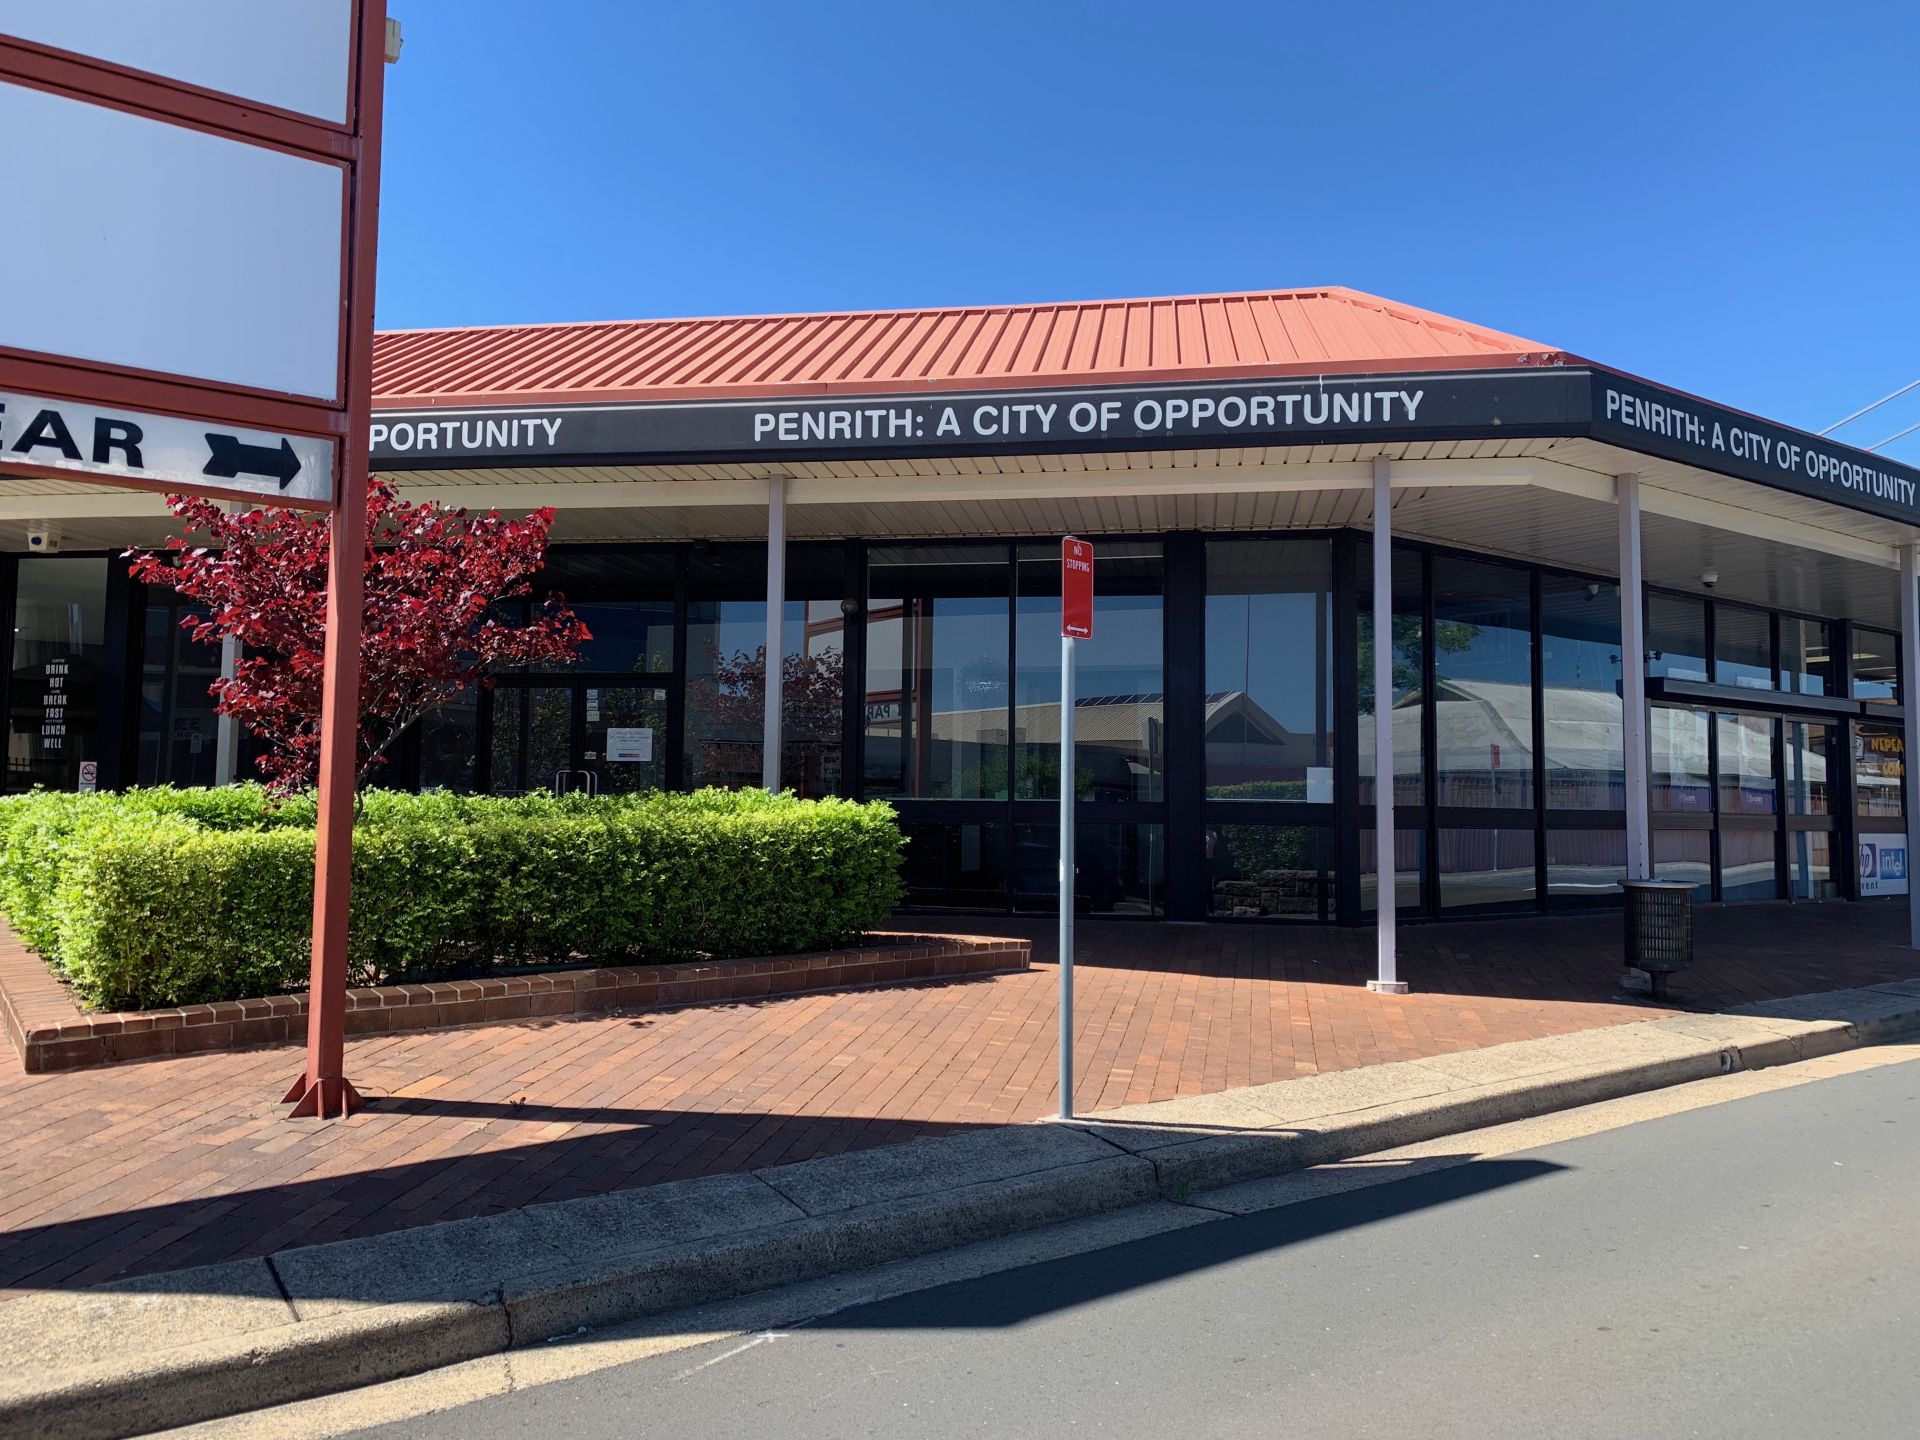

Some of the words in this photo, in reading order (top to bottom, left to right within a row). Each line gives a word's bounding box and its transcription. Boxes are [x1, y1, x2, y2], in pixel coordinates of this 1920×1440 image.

[754, 409, 923, 442] PENRITH:
[936, 407, 961, 437] A
[973, 404, 1058, 435] CITY
[1069, 401, 1122, 433] OF
[1133, 390, 1424, 431] OPPORTUNITY
[0, 403, 144, 469] AR
[1606, 389, 1706, 446] PENRITH:
[1711, 422, 1726, 452] A
[1730, 428, 1771, 464] CITY
[1776, 441, 1801, 472] OF
[1805, 450, 1916, 506] OPPORTUNITY
[1073, 543, 1082, 556] NO
[1066, 559, 1089, 572] STOPPING
[45, 664, 69, 675] DRINK
[49, 677, 64, 688] HOT
[43, 695, 67, 705] BREAK
[45, 708, 64, 718] FAST
[41, 725, 66, 735] LUNCH
[43, 738, 62, 749] WELL
[1881, 851, 1904, 877] intel
